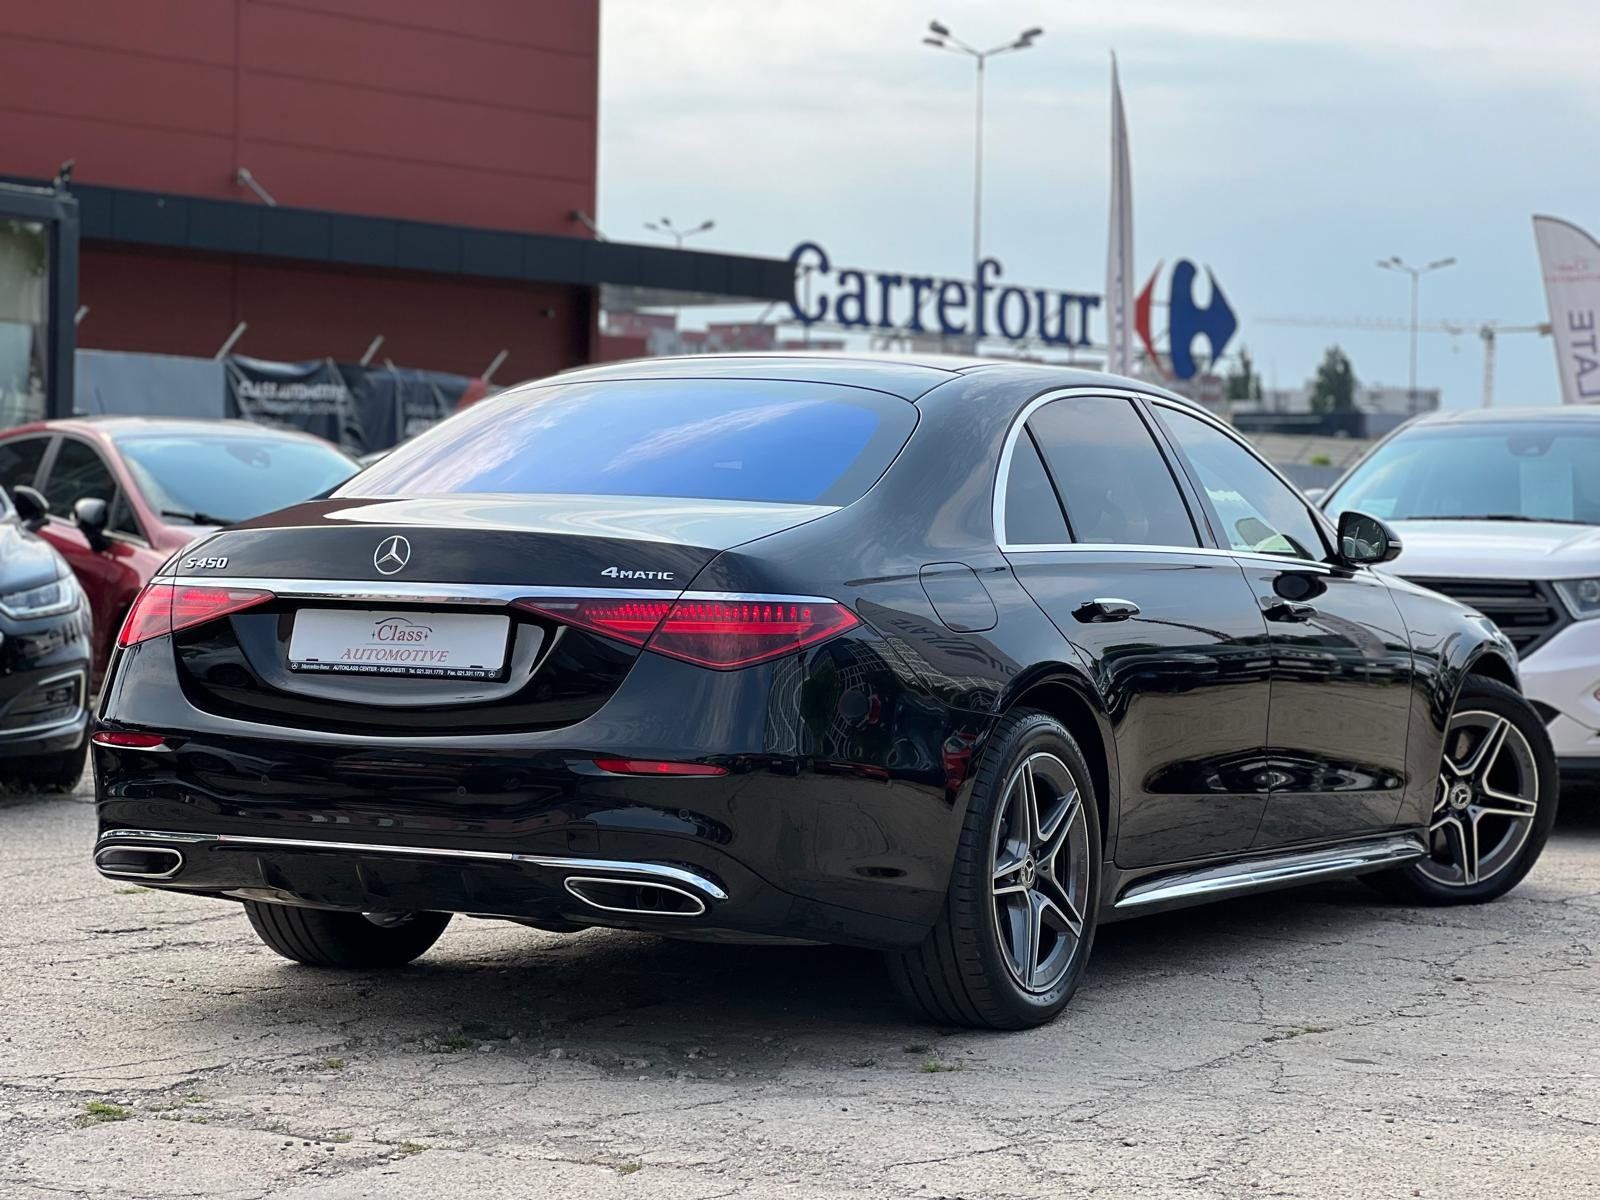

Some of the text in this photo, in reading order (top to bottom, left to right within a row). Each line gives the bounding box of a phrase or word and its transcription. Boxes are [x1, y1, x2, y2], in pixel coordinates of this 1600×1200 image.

[788, 241, 1101, 347] Carrefour
[185, 555, 229, 570] S450
[601, 566, 675, 582] 4MATIC
[375, 623, 424, 642] Class
[340, 647, 450, 664] AUTOMOTIVE
